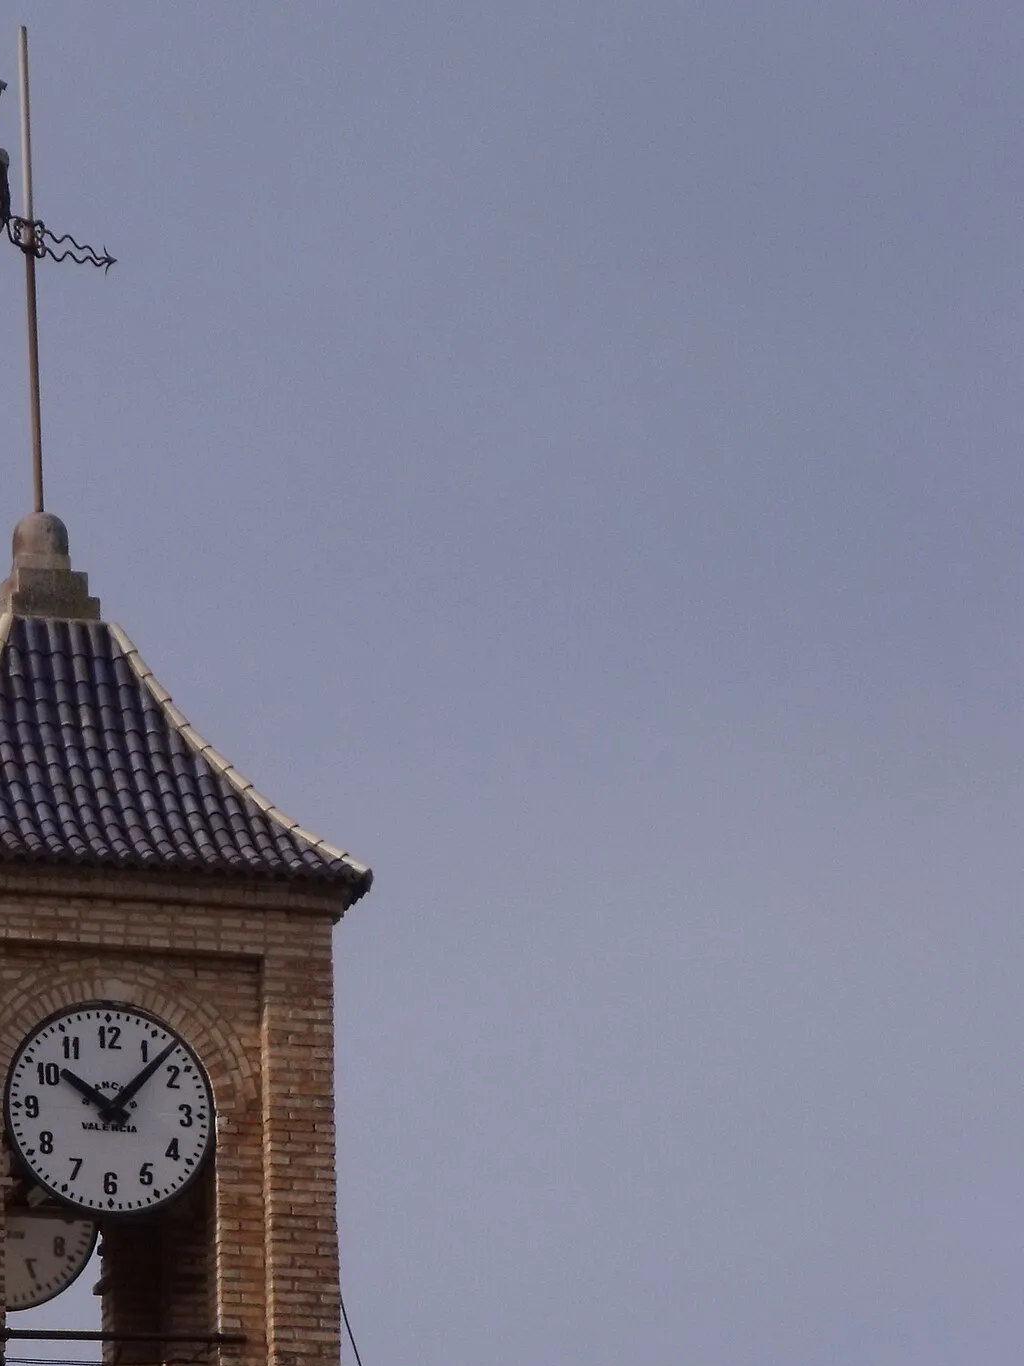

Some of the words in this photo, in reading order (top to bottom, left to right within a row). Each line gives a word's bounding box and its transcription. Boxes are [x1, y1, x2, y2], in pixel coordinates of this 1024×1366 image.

[62, 1036, 79, 1060] 11
[99, 1025, 122, 1050] 12
[140, 1039, 148, 1063] 1
[37, 1062, 60, 1086] 10
[166, 1065, 180, 1089] 2
[24, 1095, 40, 1119] 9
[178, 1104, 193, 1128] 3
[81, 1121, 138, 1133] VALENCIA
[39, 1131, 53, 1155] 8
[165, 1137, 180, 1161] 4
[69, 1157, 83, 1181] 7
[139, 1162, 154, 1186] 5
[103, 1172, 118, 1195] 6
